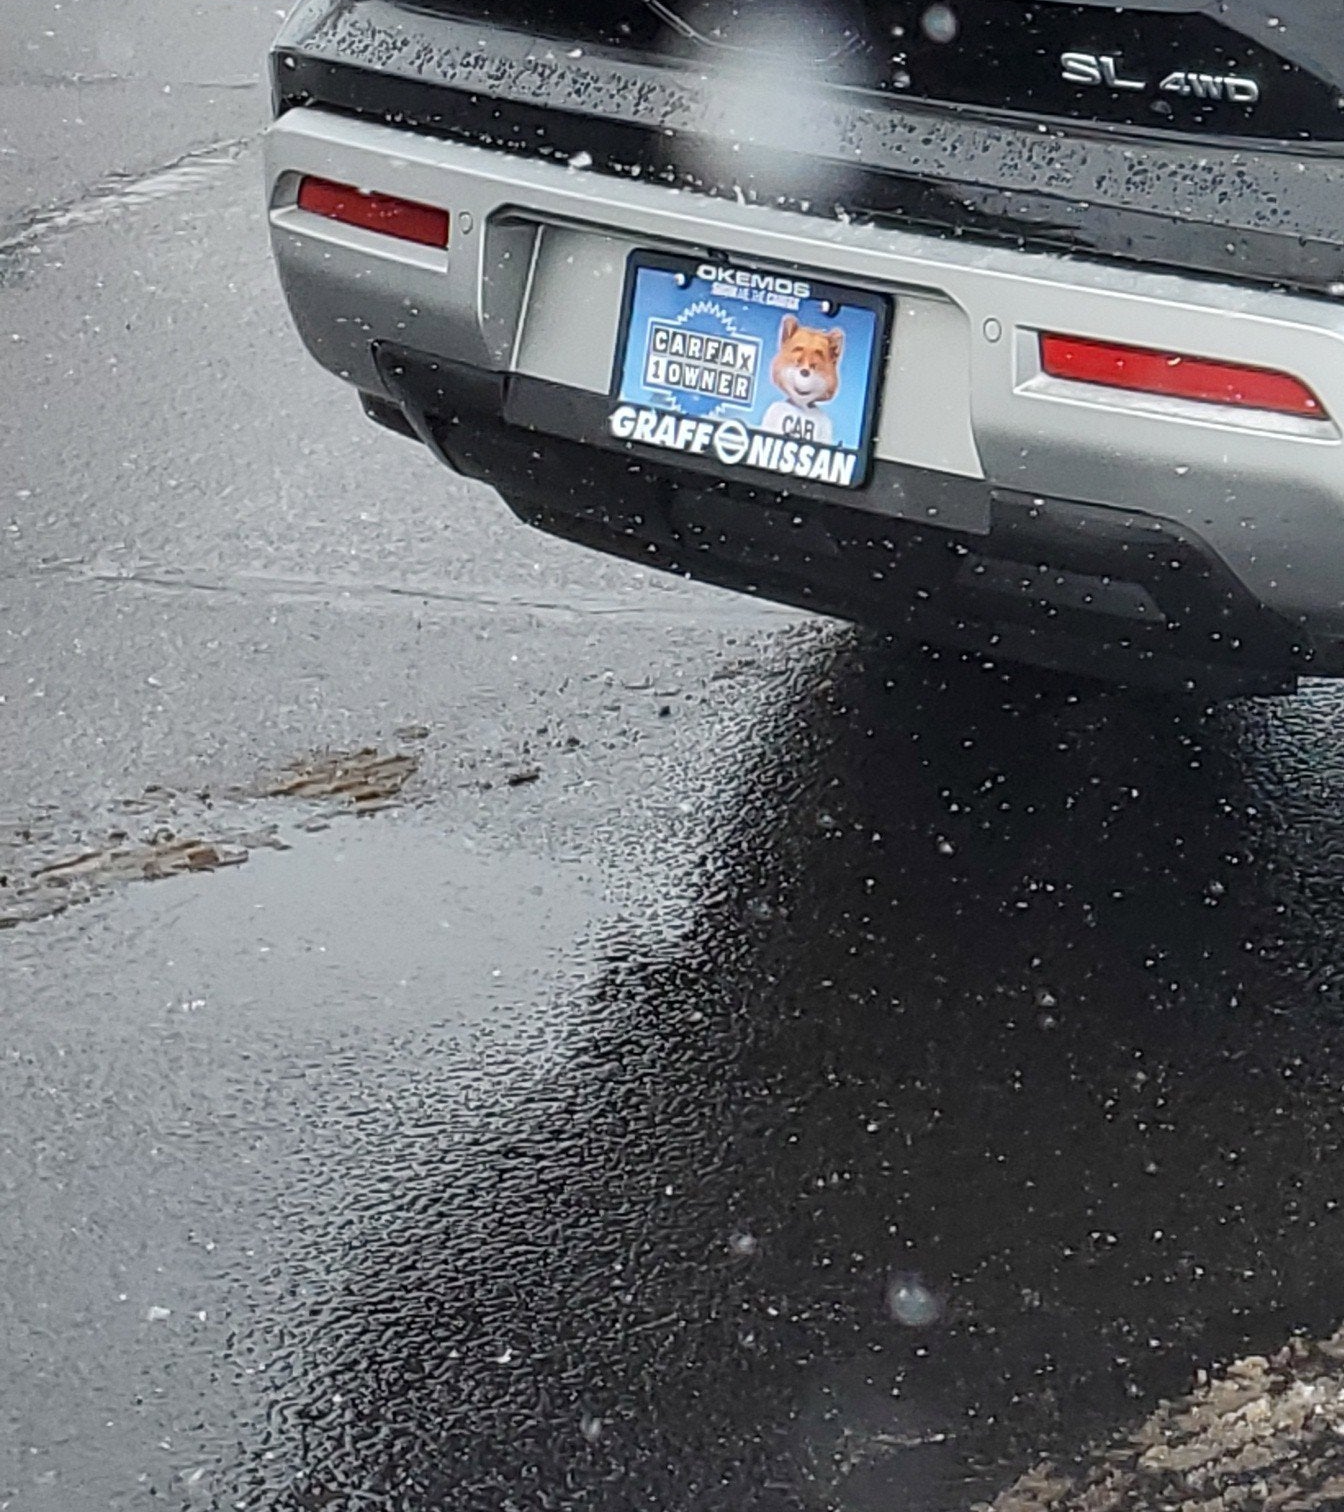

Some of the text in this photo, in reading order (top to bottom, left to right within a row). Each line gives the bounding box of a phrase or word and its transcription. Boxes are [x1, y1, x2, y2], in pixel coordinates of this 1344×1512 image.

[1060, 51, 1260, 102] SL 4WD
[696, 264, 811, 298] OKEMOS
[655, 328, 753, 371] CARFAX
[651, 360, 749, 399] 1 OWNER
[610, 405, 857, 487] GRAFF NISSAN
[782, 414, 815, 439] CAR
